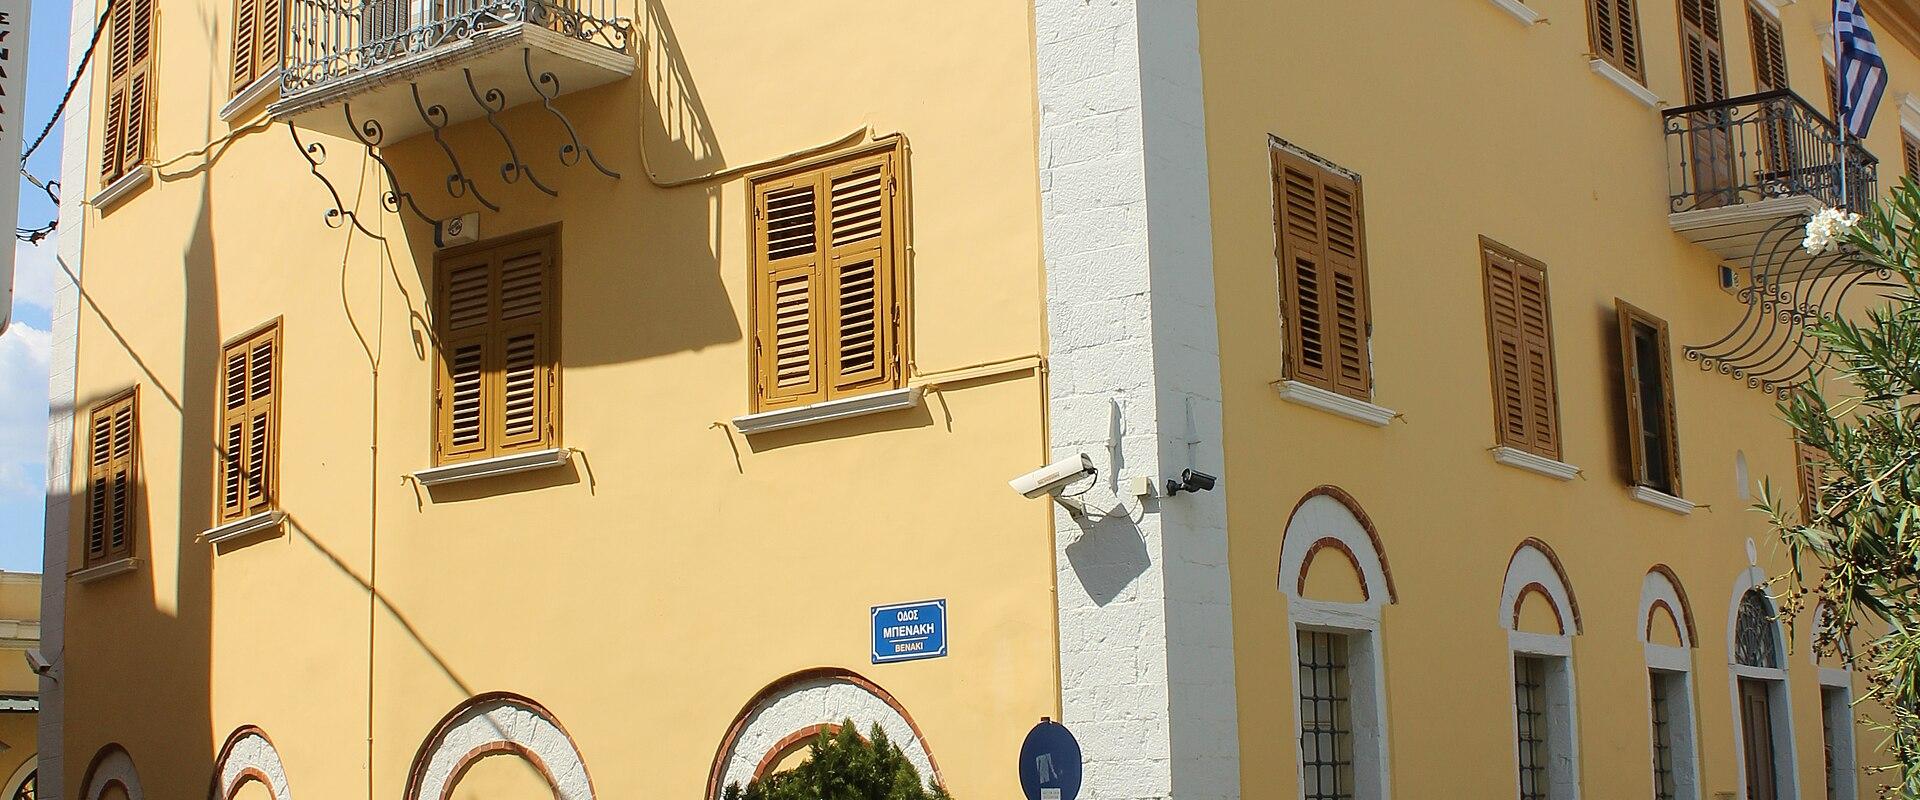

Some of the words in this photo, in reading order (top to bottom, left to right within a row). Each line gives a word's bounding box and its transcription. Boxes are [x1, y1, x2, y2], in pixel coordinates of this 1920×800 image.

[897, 609, 919, 622] ΟΔΟΣ
[883, 623, 935, 639] ΜΠΕΝΑΚΗ
[895, 642, 923, 653] BENAKI
